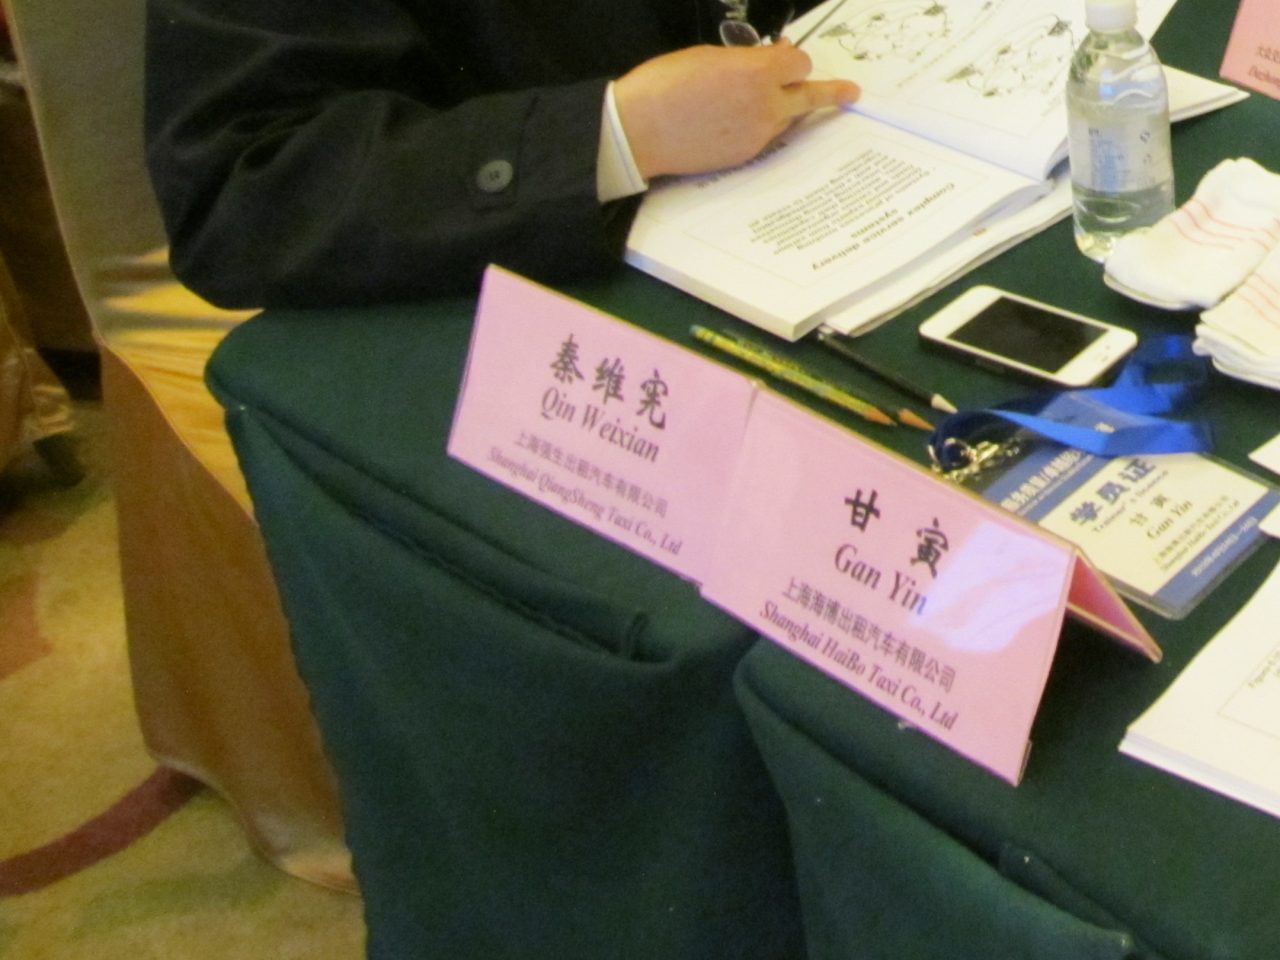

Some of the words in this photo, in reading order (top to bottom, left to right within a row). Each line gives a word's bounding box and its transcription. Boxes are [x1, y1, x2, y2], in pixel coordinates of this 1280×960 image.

[550, 333, 669, 430] 秦维宪
[541, 387, 576, 422] Qin
[583, 404, 660, 463] Weixian
[1070, 450, 1156, 525] 学员证
[1147, 518, 1173, 539] Gan
[1171, 501, 1192, 516] Yin
[606, 506, 633, 532] Taxi
[659, 532, 684, 557] Ltd
[844, 489, 950, 579] 甘寅
[834, 544, 881, 590] Gan
[889, 570, 928, 616] Yin
[759, 600, 820, 650] Shanghai
[821, 633, 866, 676] HaiBo
[867, 657, 900, 698] Taxi
[899, 678, 927, 716] Co.,
[930, 696, 960, 732] Ltd
[781, 576, 957, 694] 上海海博出租汽车有限公司
